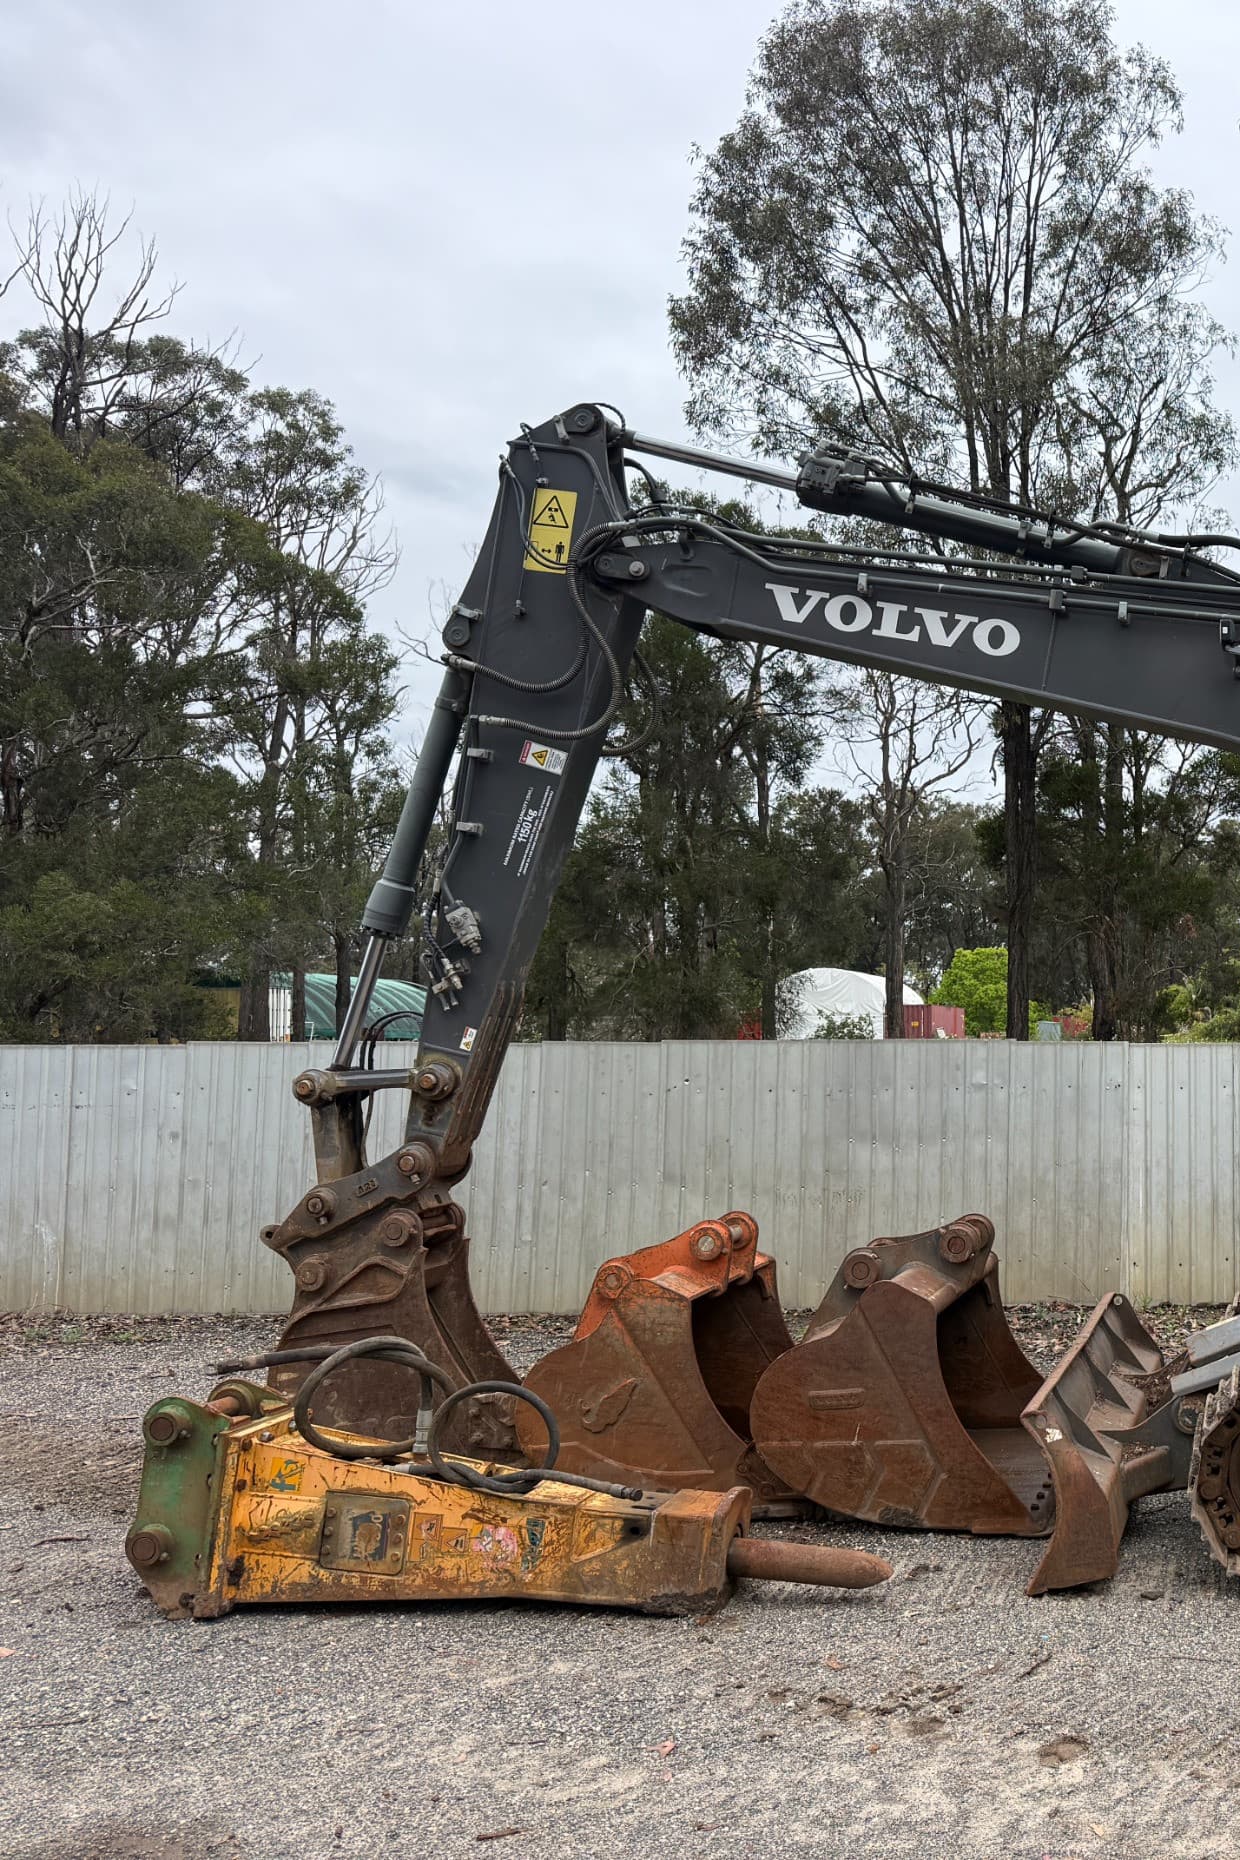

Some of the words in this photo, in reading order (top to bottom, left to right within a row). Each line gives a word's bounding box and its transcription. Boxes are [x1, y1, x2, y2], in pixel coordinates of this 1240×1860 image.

[764, 582, 1021, 657] VOLVO
[523, 808, 538, 822] kg
[517, 820, 533, 842] 1150
